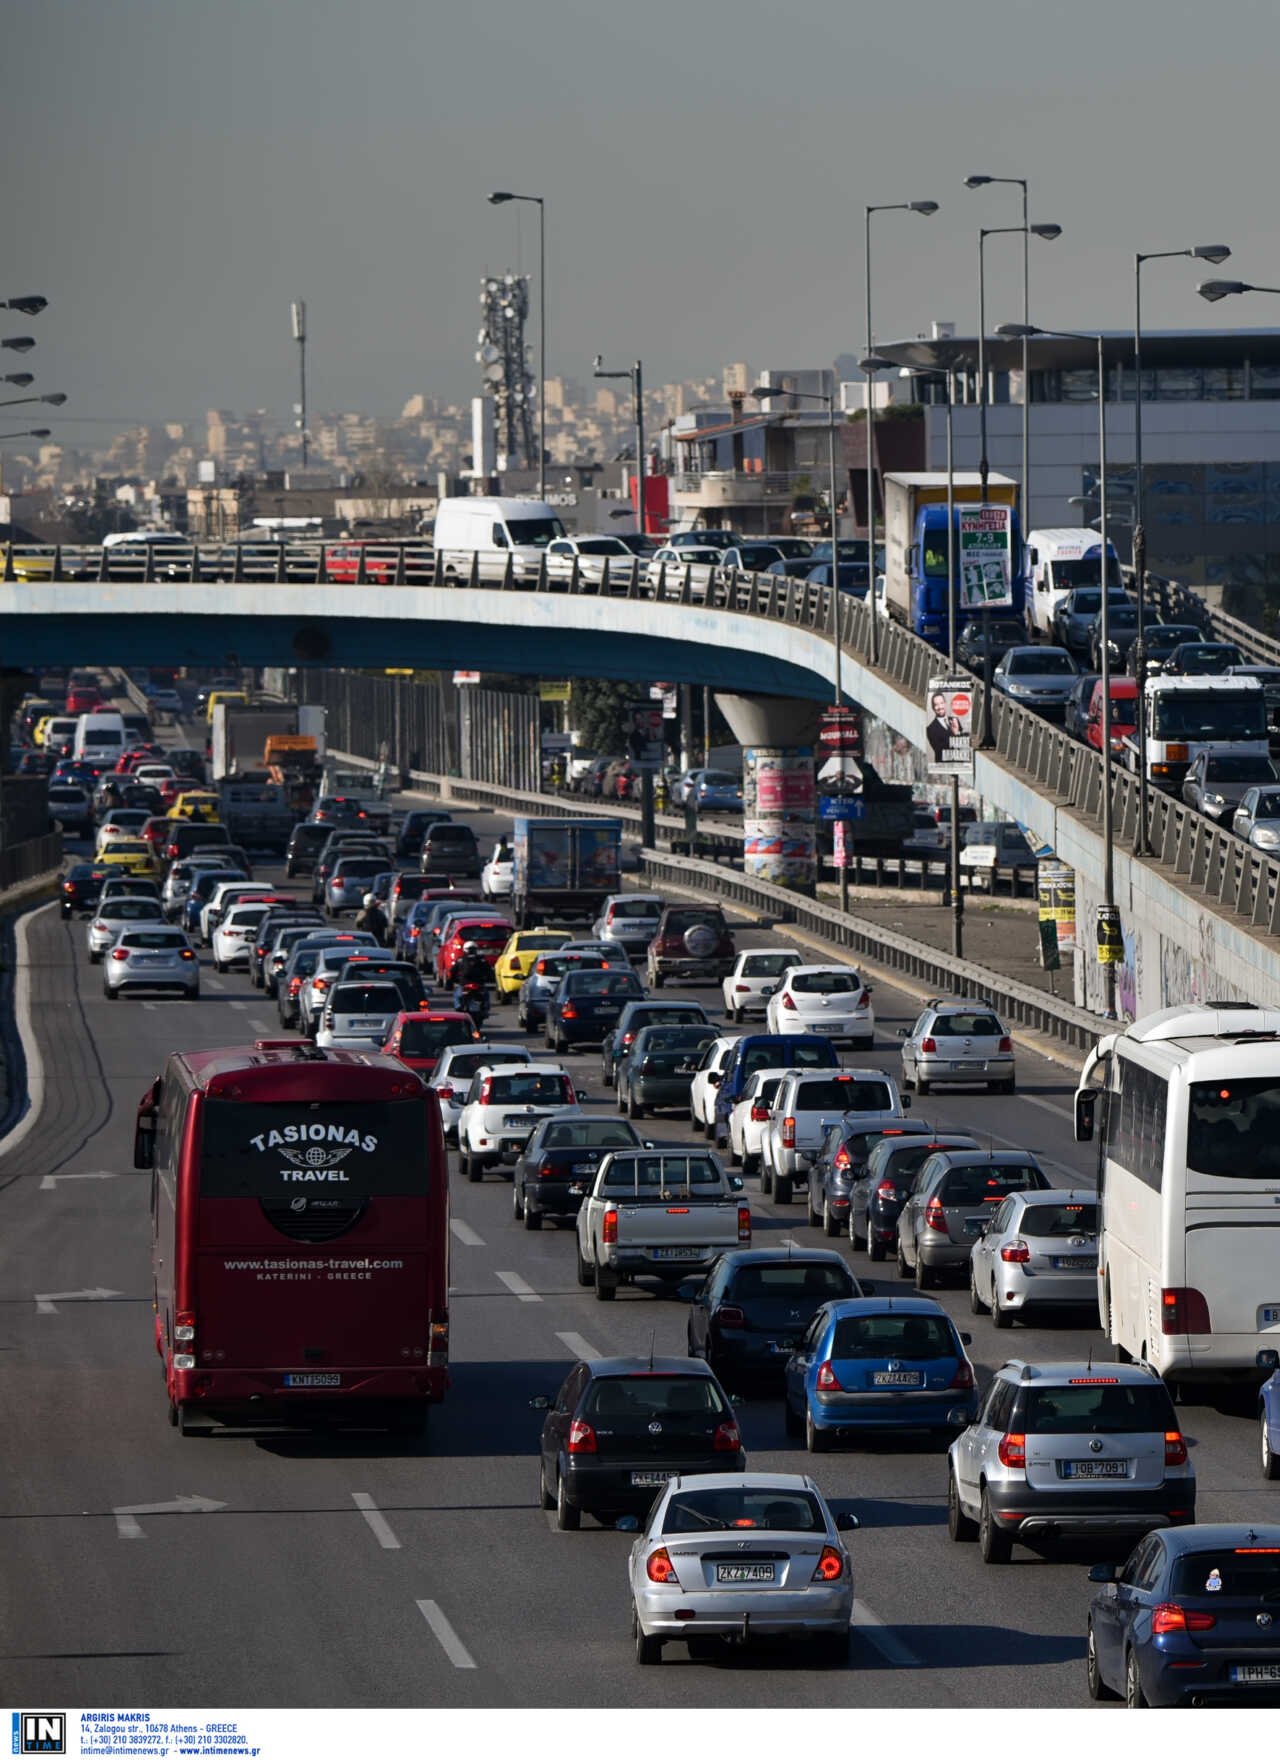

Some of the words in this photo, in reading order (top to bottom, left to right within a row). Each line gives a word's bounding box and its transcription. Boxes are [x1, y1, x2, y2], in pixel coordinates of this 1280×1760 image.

[250, 1124, 378, 1153] TASIONAS
[280, 1170, 350, 1181] TRAVEL
[223, 1257, 404, 1270] www.tasionas-travel.com
[256, 1272, 312, 1280] KATERINI
[327, 1272, 373, 1280] GREECE
